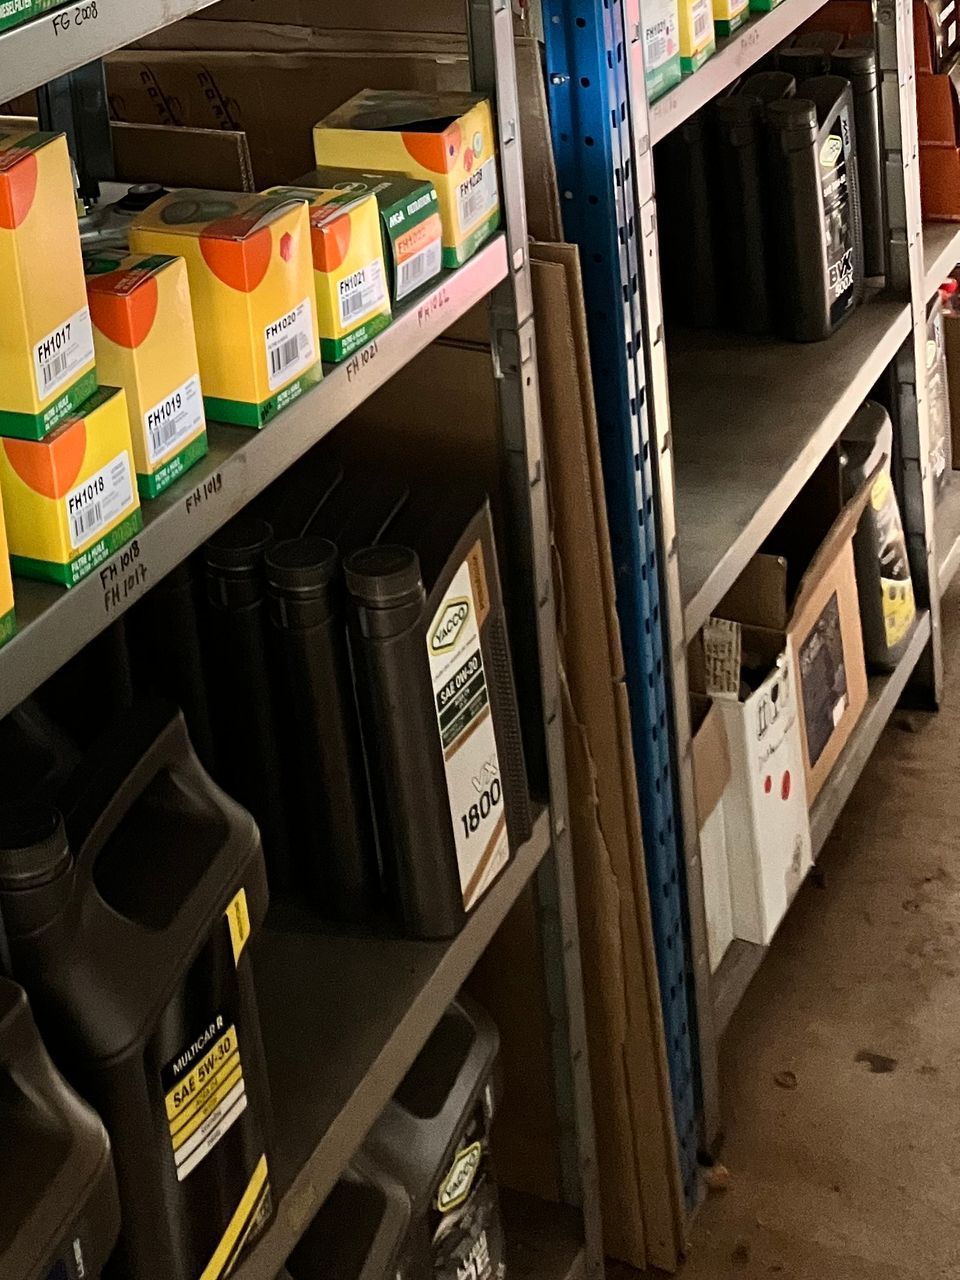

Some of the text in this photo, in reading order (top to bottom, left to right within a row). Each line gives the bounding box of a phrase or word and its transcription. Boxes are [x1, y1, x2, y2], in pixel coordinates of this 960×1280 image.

[339, 271, 366, 296] FH1021
[36, 322, 72, 364] FH1017
[264, 310, 298, 340] FH1020
[146, 392, 183, 432] FH1019
[67, 475, 106, 516] FH1018
[434, 604, 468, 645] YACCO
[461, 778, 501, 840] 1800
[171, 1024, 216, 1077] MULTICAR
[171, 1080, 196, 1109] SAE
[197, 1035, 232, 1083] 5W-30
